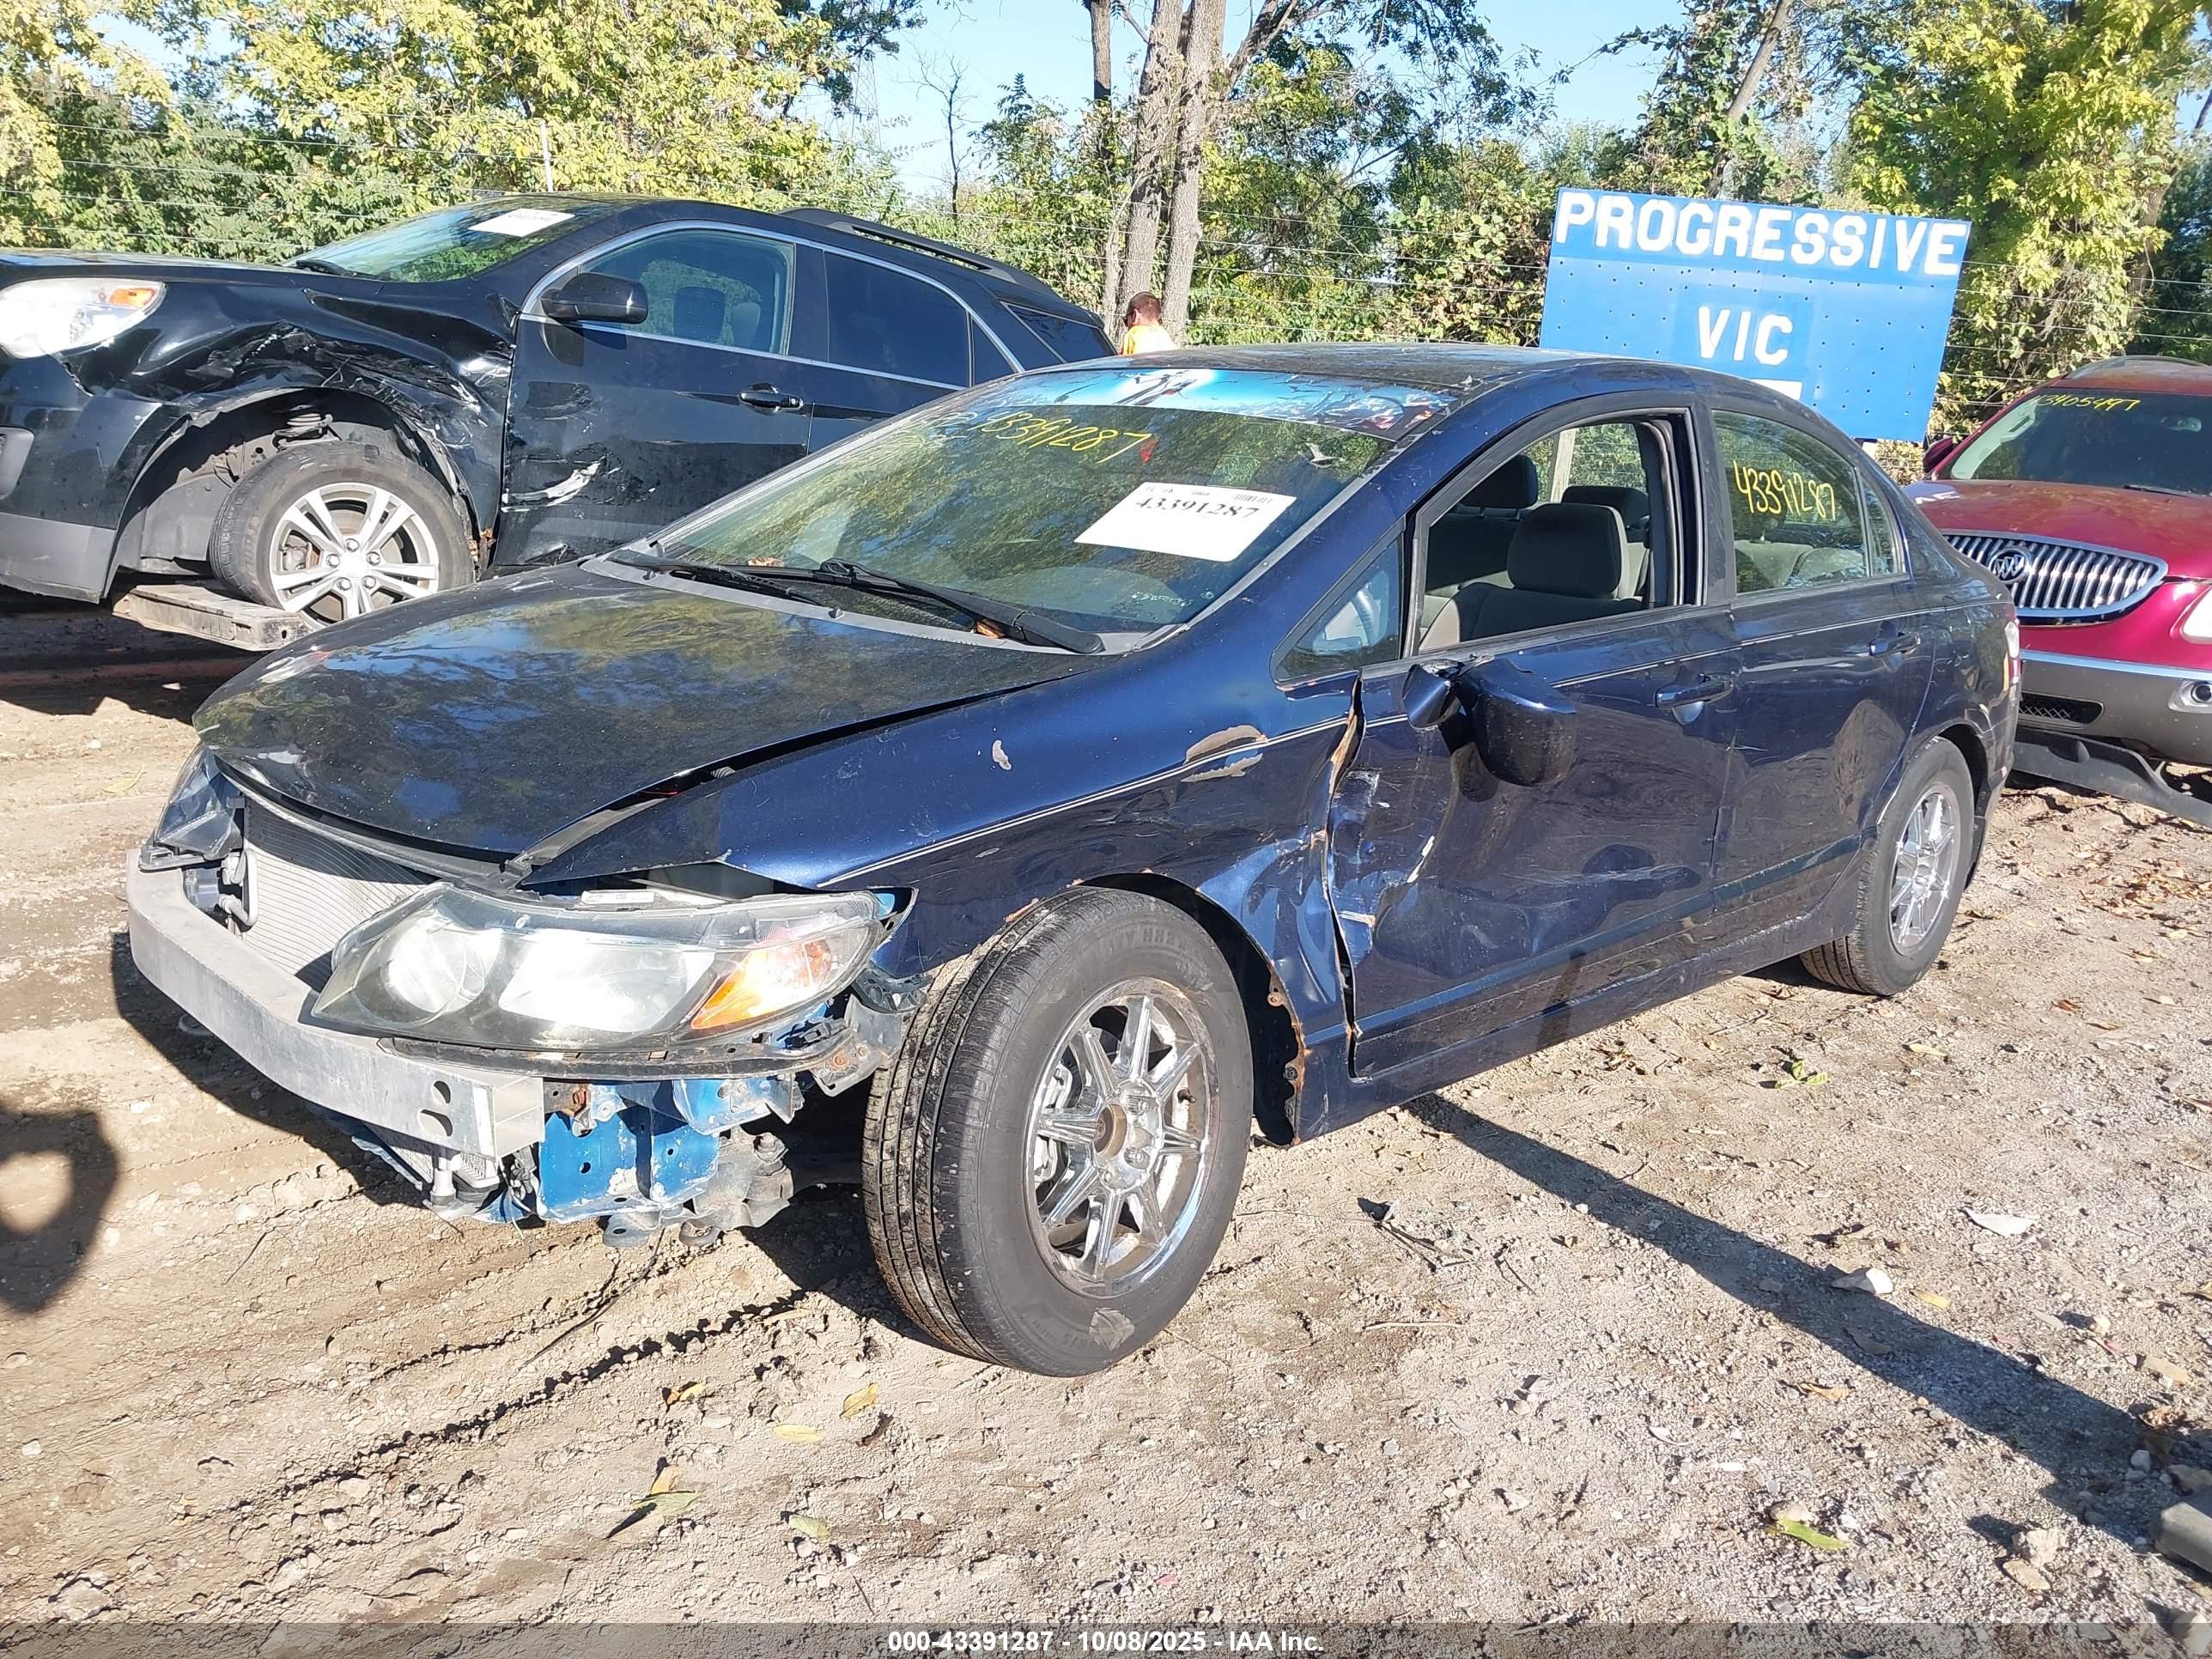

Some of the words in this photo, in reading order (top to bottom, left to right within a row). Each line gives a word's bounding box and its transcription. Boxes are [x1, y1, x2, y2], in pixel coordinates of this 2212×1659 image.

[1555, 191, 1970, 276] PROGRESSIVE
[1698, 306, 1793, 366] VIC
[1135, 496, 1260, 519] 43391287
[1733, 459, 1836, 521] 43391287
